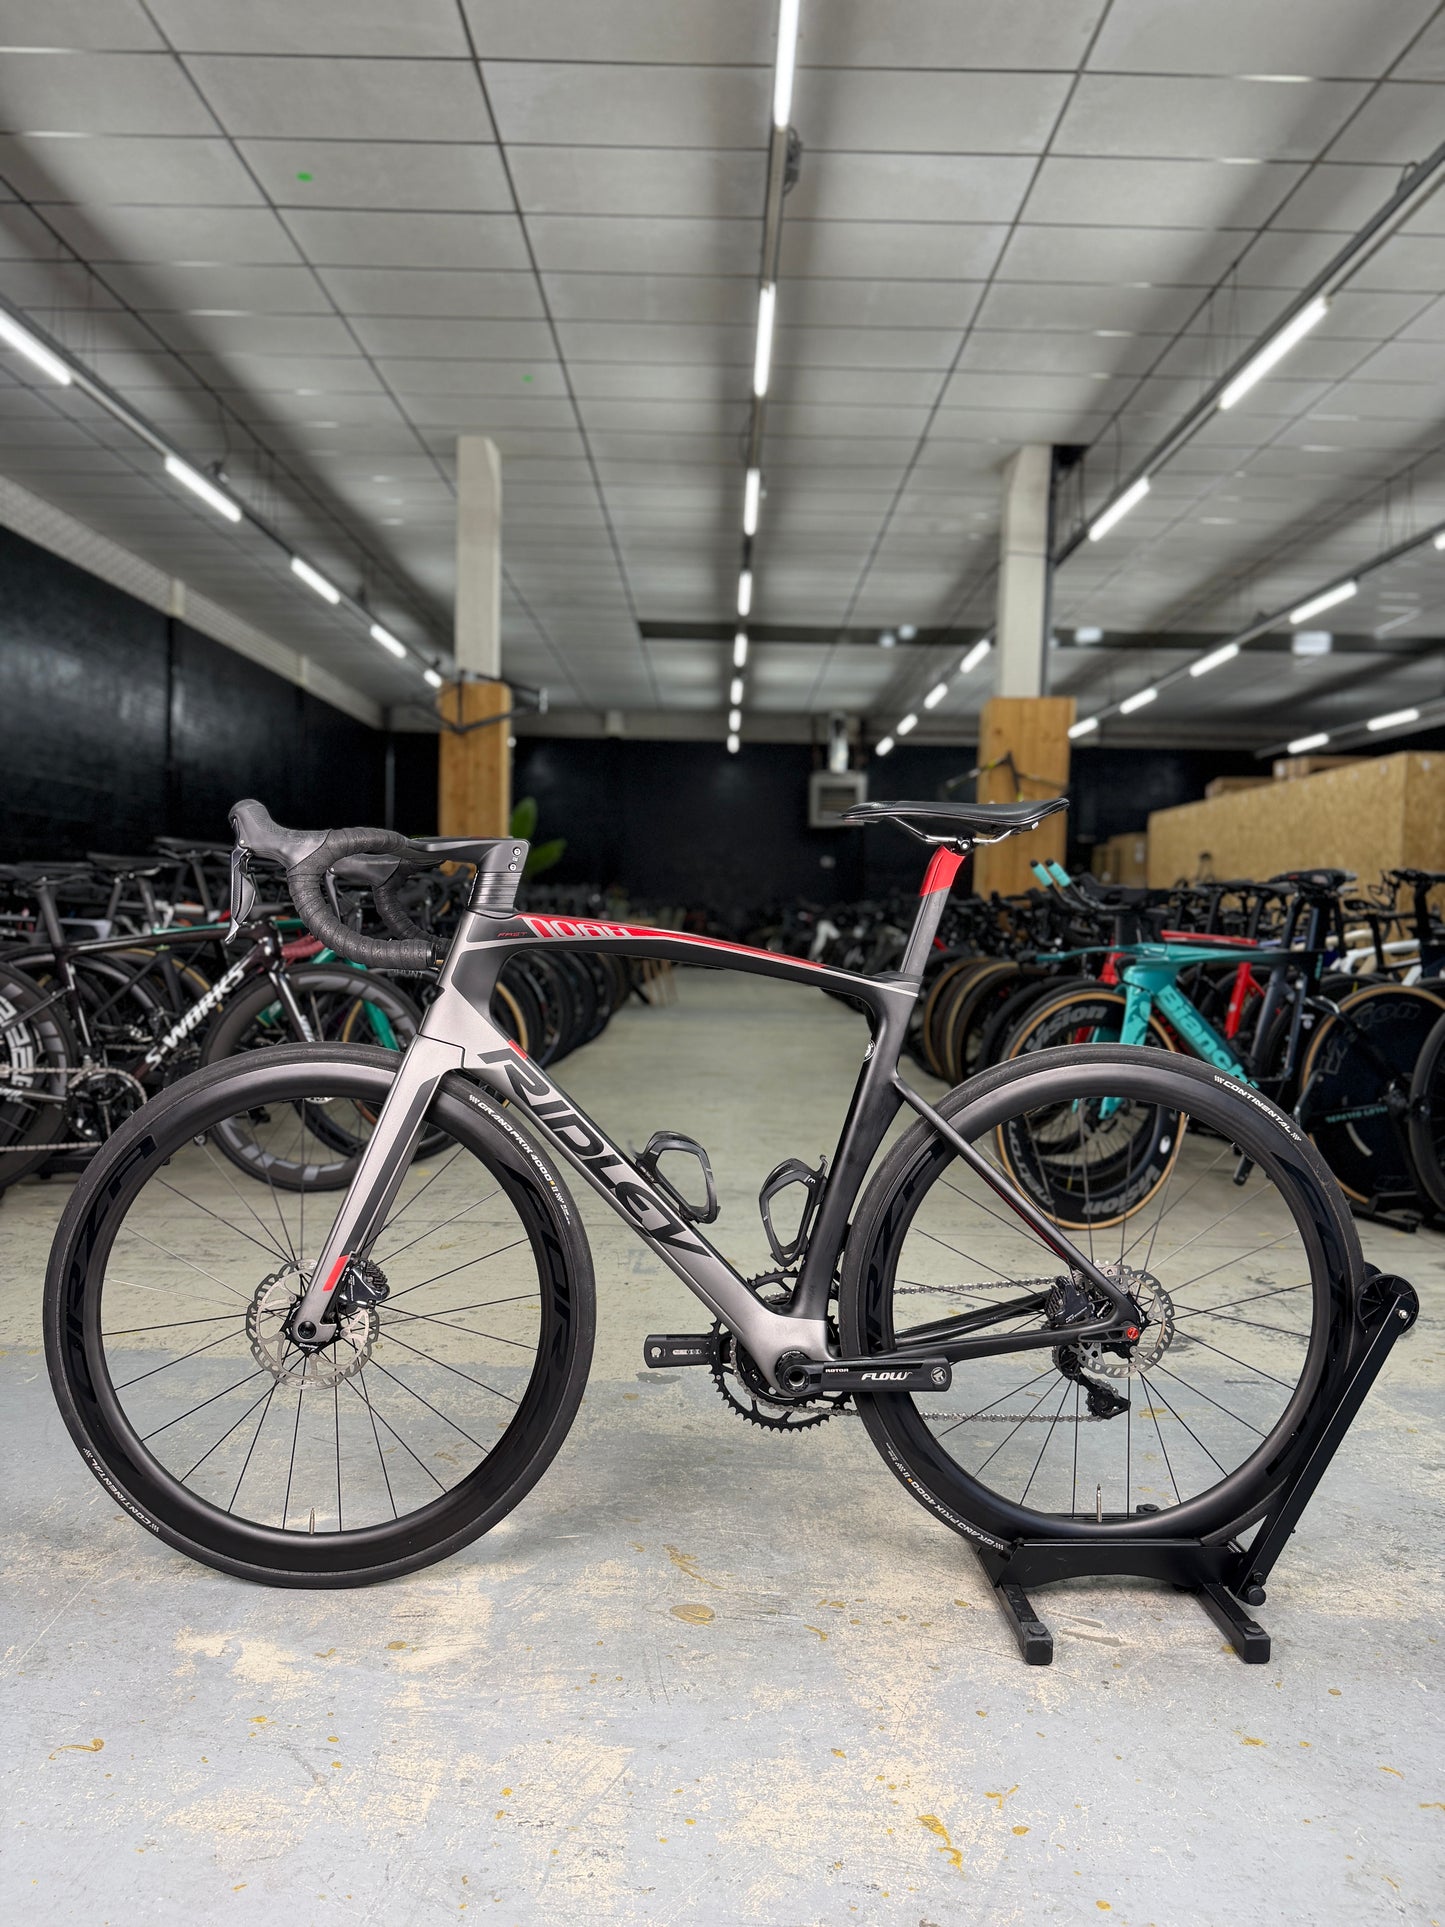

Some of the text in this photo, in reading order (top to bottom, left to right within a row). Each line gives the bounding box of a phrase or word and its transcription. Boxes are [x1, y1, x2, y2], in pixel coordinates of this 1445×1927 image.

[521, 917, 633, 938] NOAH
[145, 962, 245, 1071] S-WORKS
[478, 1101, 512, 1132] GRAND
[509, 1130, 533, 1154] PRIX
[1222, 1080, 1292, 1134] CONTINENTAL
[477, 1047, 713, 1259] RIDLEY
[860, 1370, 912, 1381] FLOW
[92, 1458, 151, 1525] CONTINENTAL
[934, 1504, 959, 1525] PRIX
[957, 1522, 995, 1546] GRAND
